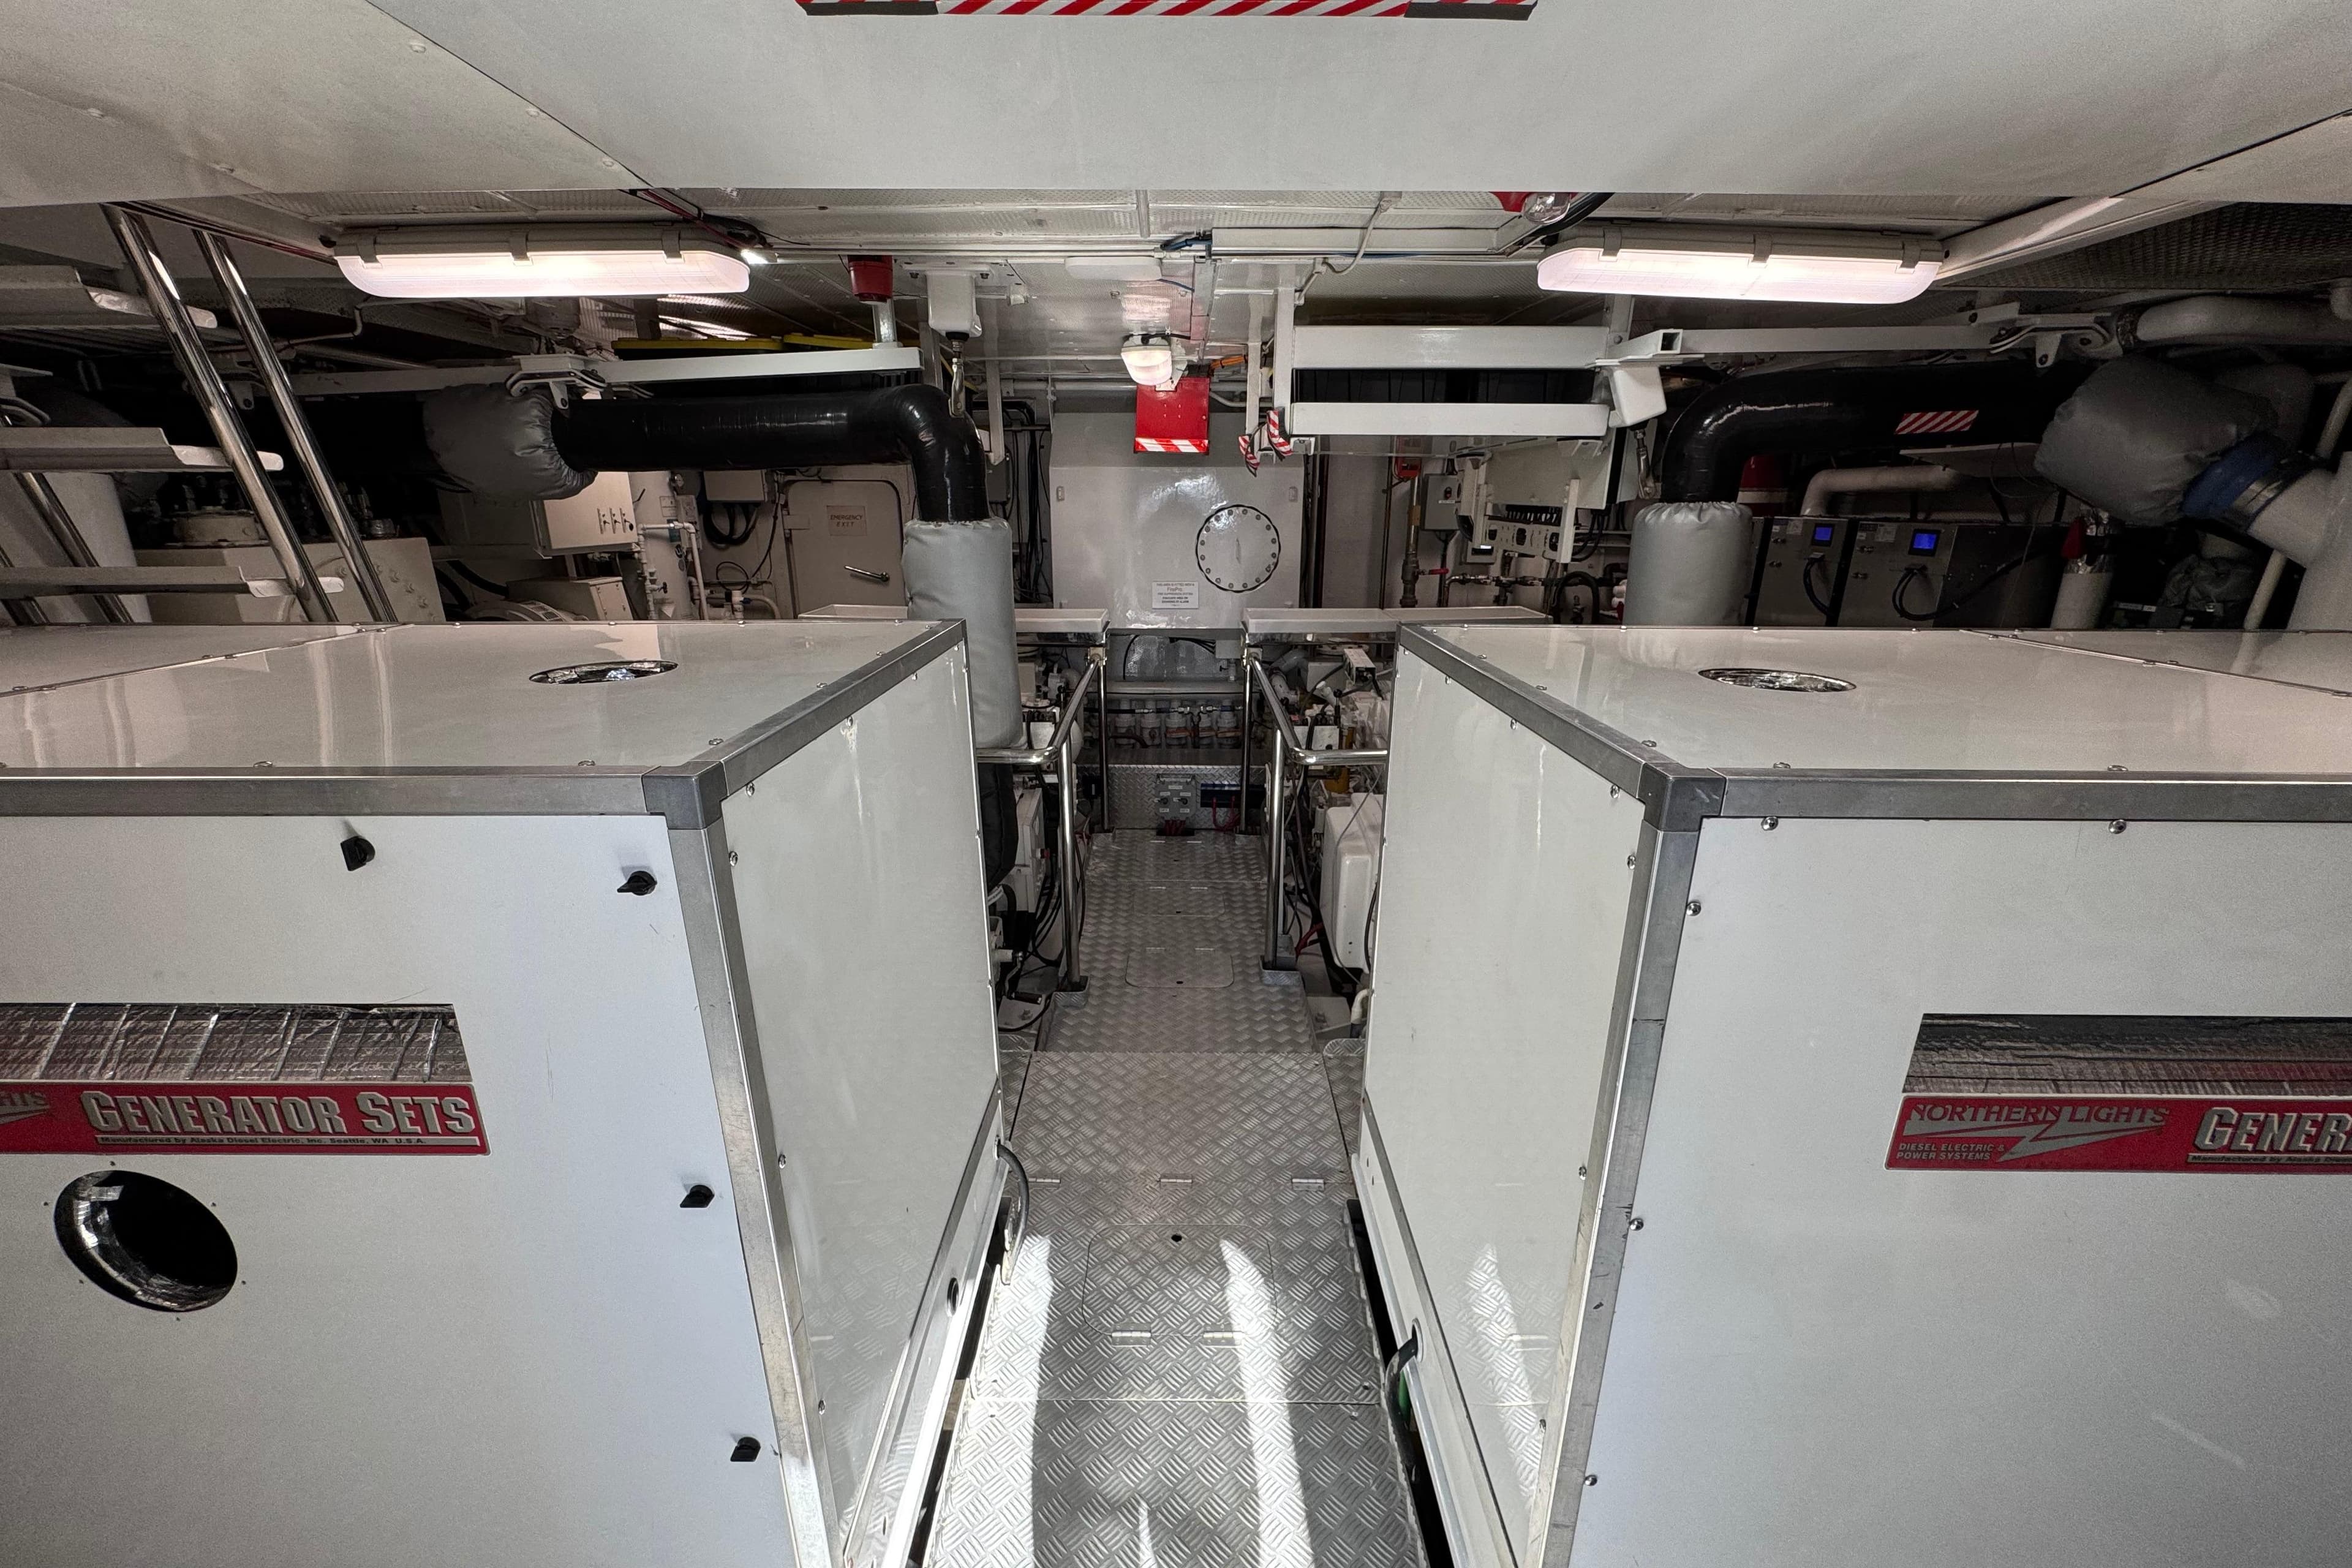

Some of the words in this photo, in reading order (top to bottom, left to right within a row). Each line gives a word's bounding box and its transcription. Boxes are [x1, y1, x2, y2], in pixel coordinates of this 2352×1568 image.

[80, 1090, 348, 1134] GENERATOR
[356, 1091, 476, 1134] SETS
[1907, 1104, 2062, 1123] NORTHERN
[2068, 1106, 2173, 1123] LIGHTS
[2194, 1106, 2352, 1152] GENER
